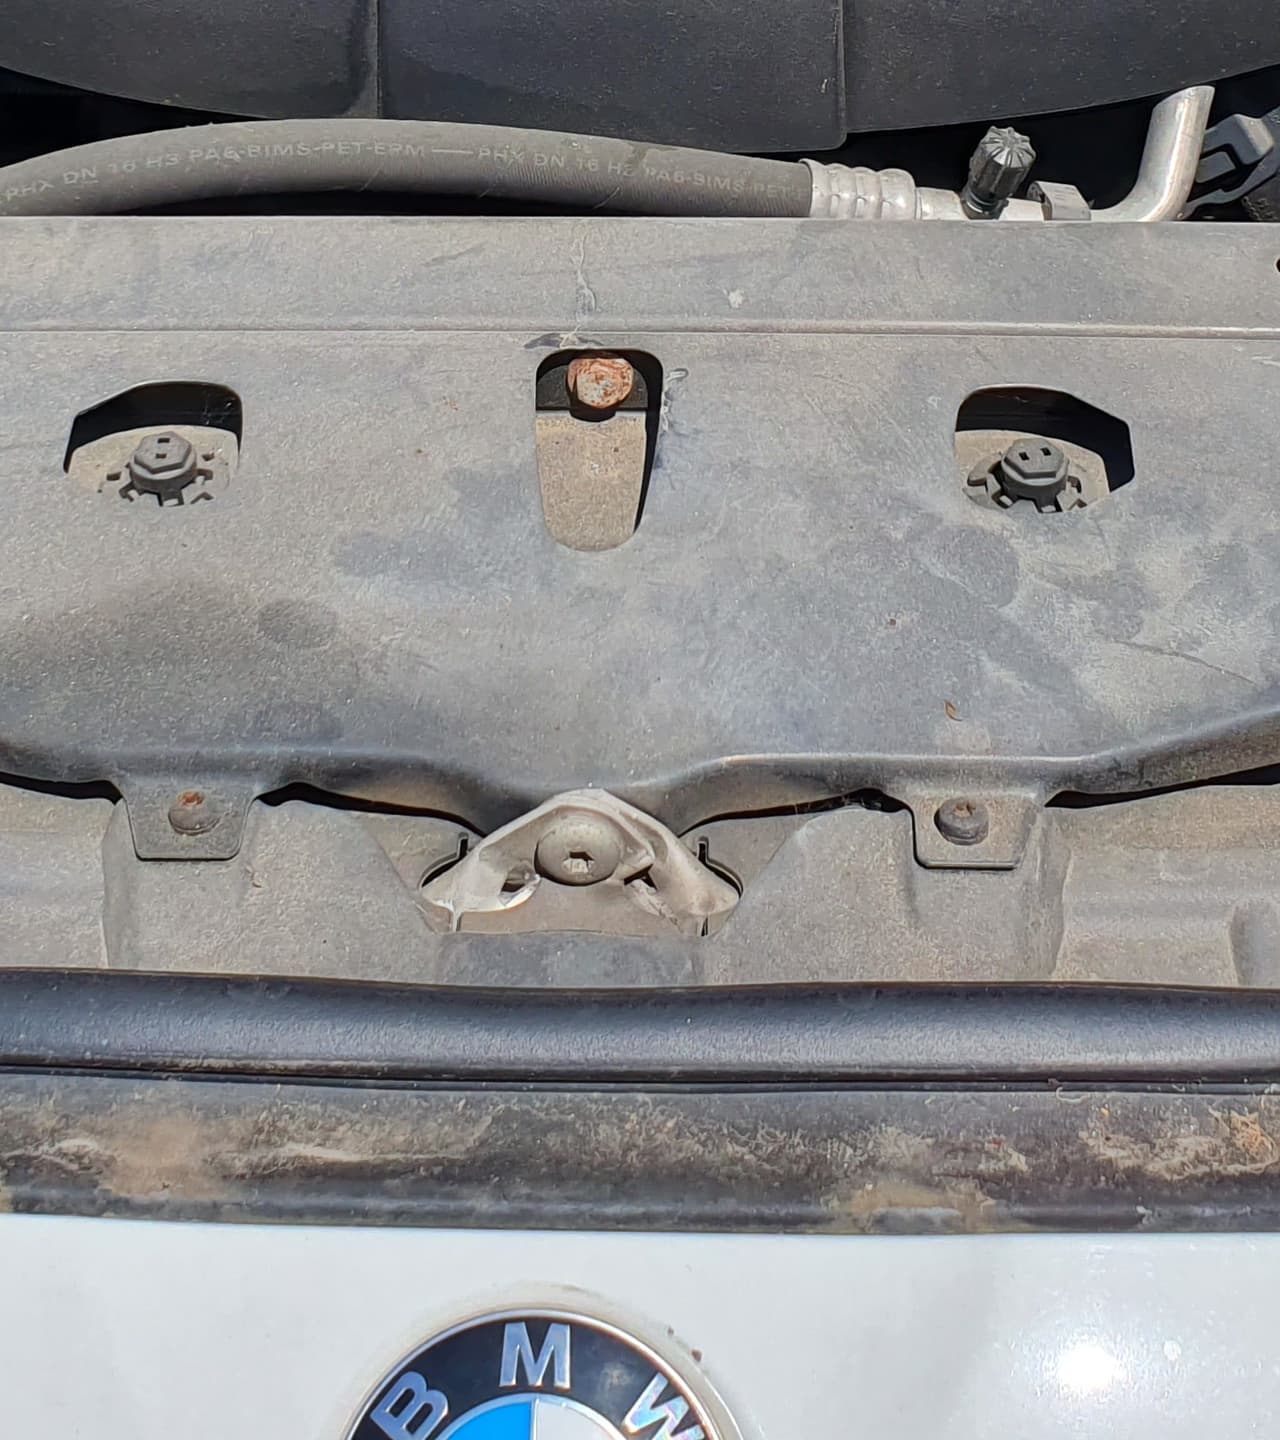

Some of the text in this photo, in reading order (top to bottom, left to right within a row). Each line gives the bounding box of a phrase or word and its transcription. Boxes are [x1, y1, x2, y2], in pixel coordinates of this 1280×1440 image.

[63, 167, 97, 185] DN
[534, 153, 565, 169] DN
[369, 1321, 707, 1440] BMW
